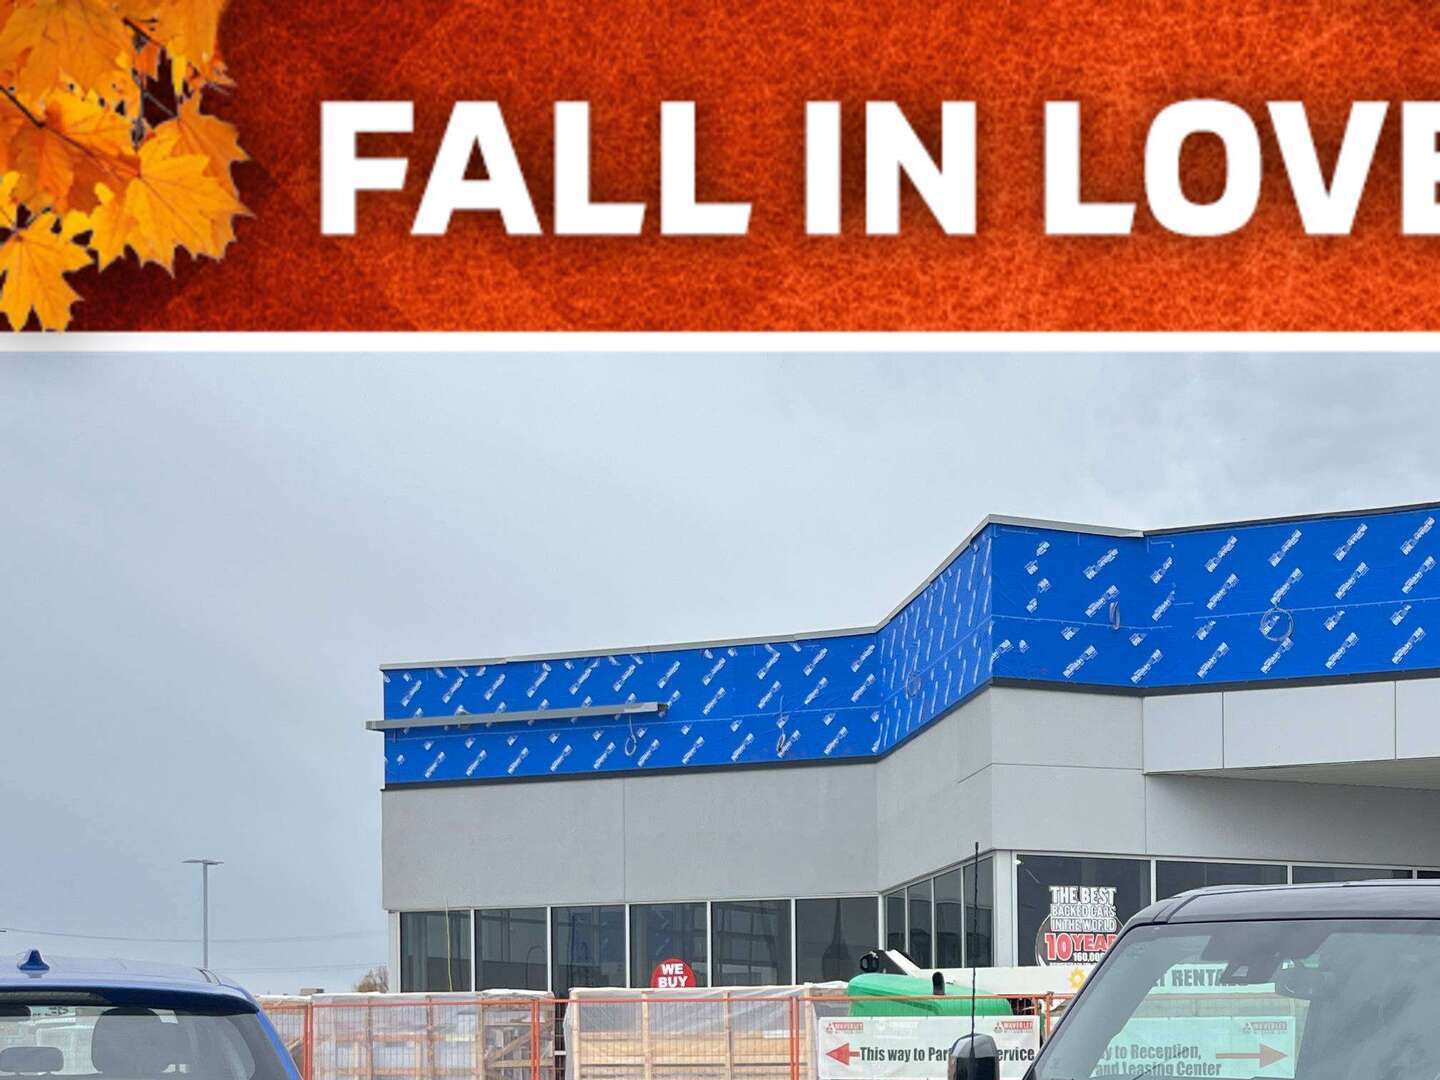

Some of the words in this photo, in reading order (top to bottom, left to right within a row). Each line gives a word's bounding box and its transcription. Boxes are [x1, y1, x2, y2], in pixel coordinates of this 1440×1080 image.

[1049, 886, 1078, 904] THE
[1080, 886, 1117, 906] BEST
[1050, 904, 1089, 918] BACKED
[1090, 904, 1117, 918] CARS
[1051, 918, 1062, 932] IN
[1062, 918, 1081, 932] THE
[1082, 918, 1117, 932] WORLD
[1044, 932, 1073, 961] 10
[660, 963, 684, 975] WE
[657, 976, 688, 988] BUY
[860, 1047, 885, 1061] This
[888, 1048, 911, 1062] way
[914, 1048, 926, 1061] to
[996, 1046, 1035, 1061] ervice
[1115, 1044, 1127, 1059] to
[1130, 1044, 1201, 1061] Reception,
[1176, 1061, 1222, 1076] Center
